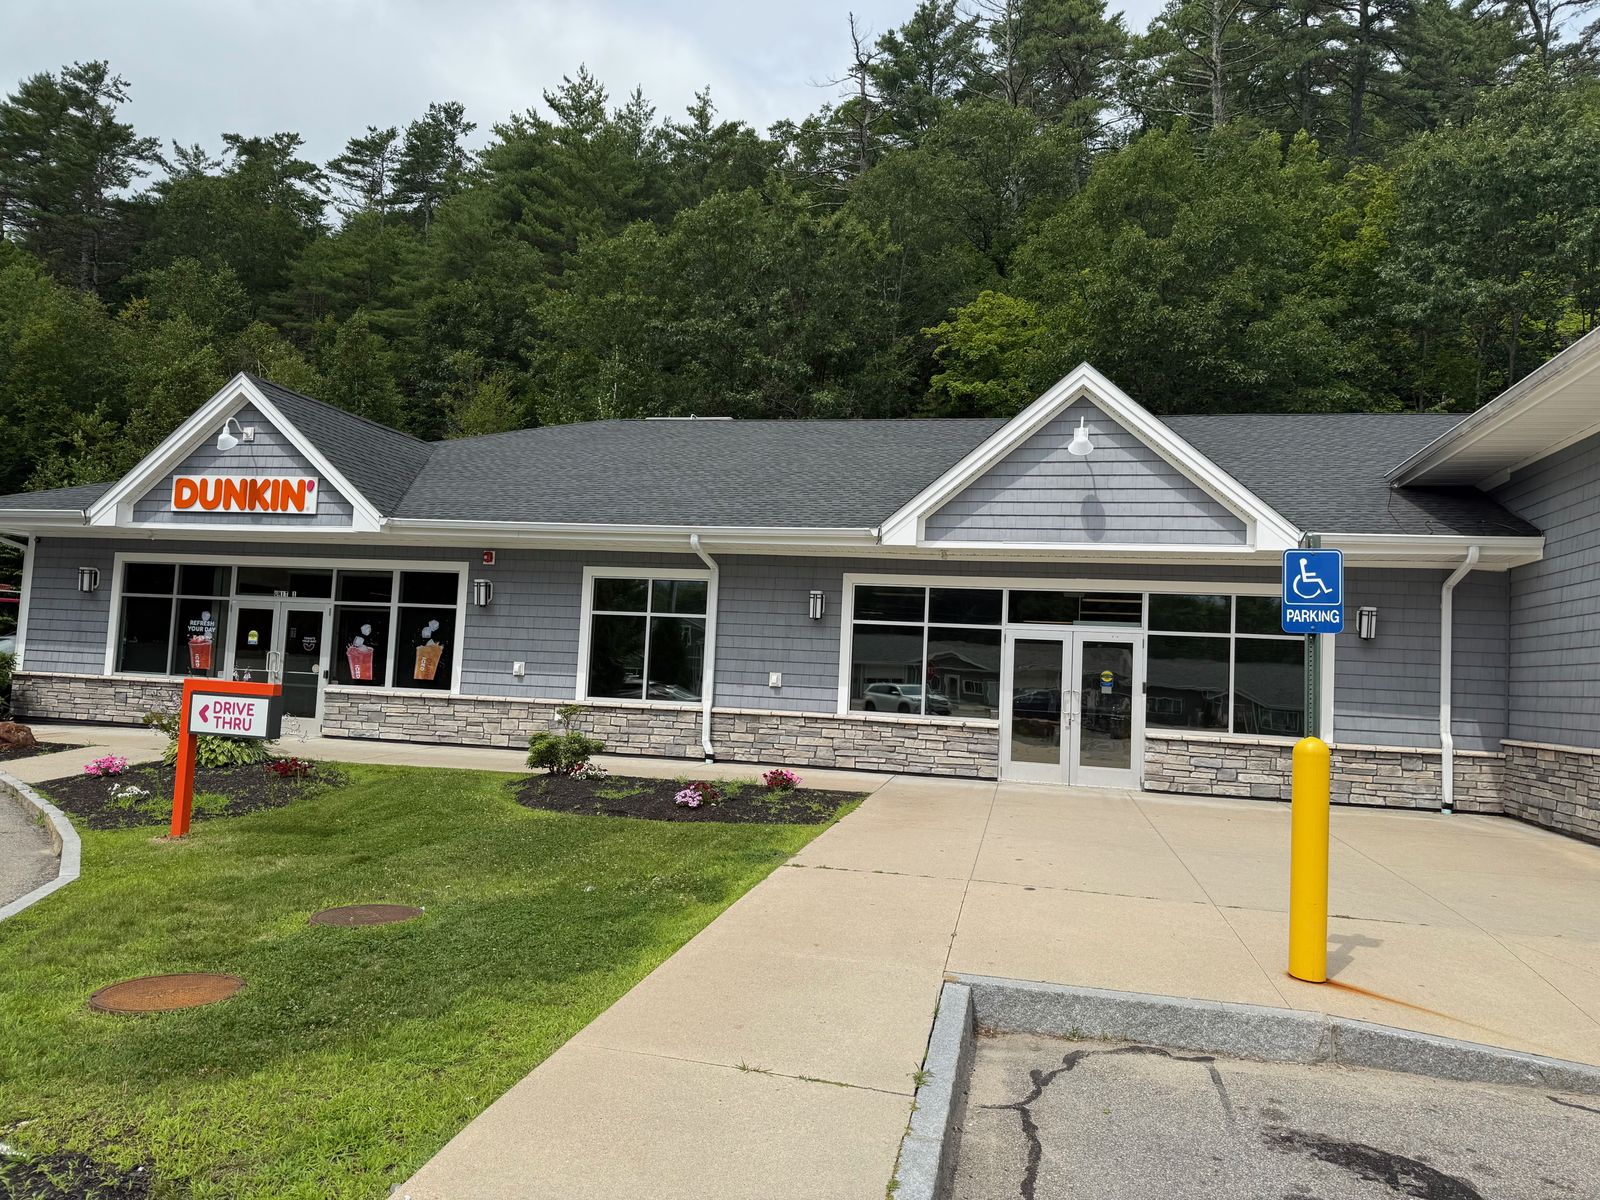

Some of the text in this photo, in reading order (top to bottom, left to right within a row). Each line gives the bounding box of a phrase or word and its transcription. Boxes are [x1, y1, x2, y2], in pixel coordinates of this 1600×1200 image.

[174, 478, 315, 512] DUNKIN'
[1286, 609, 1340, 624] PARKING
[213, 701, 255, 717] DRIVE
[213, 716, 252, 732] THRU
